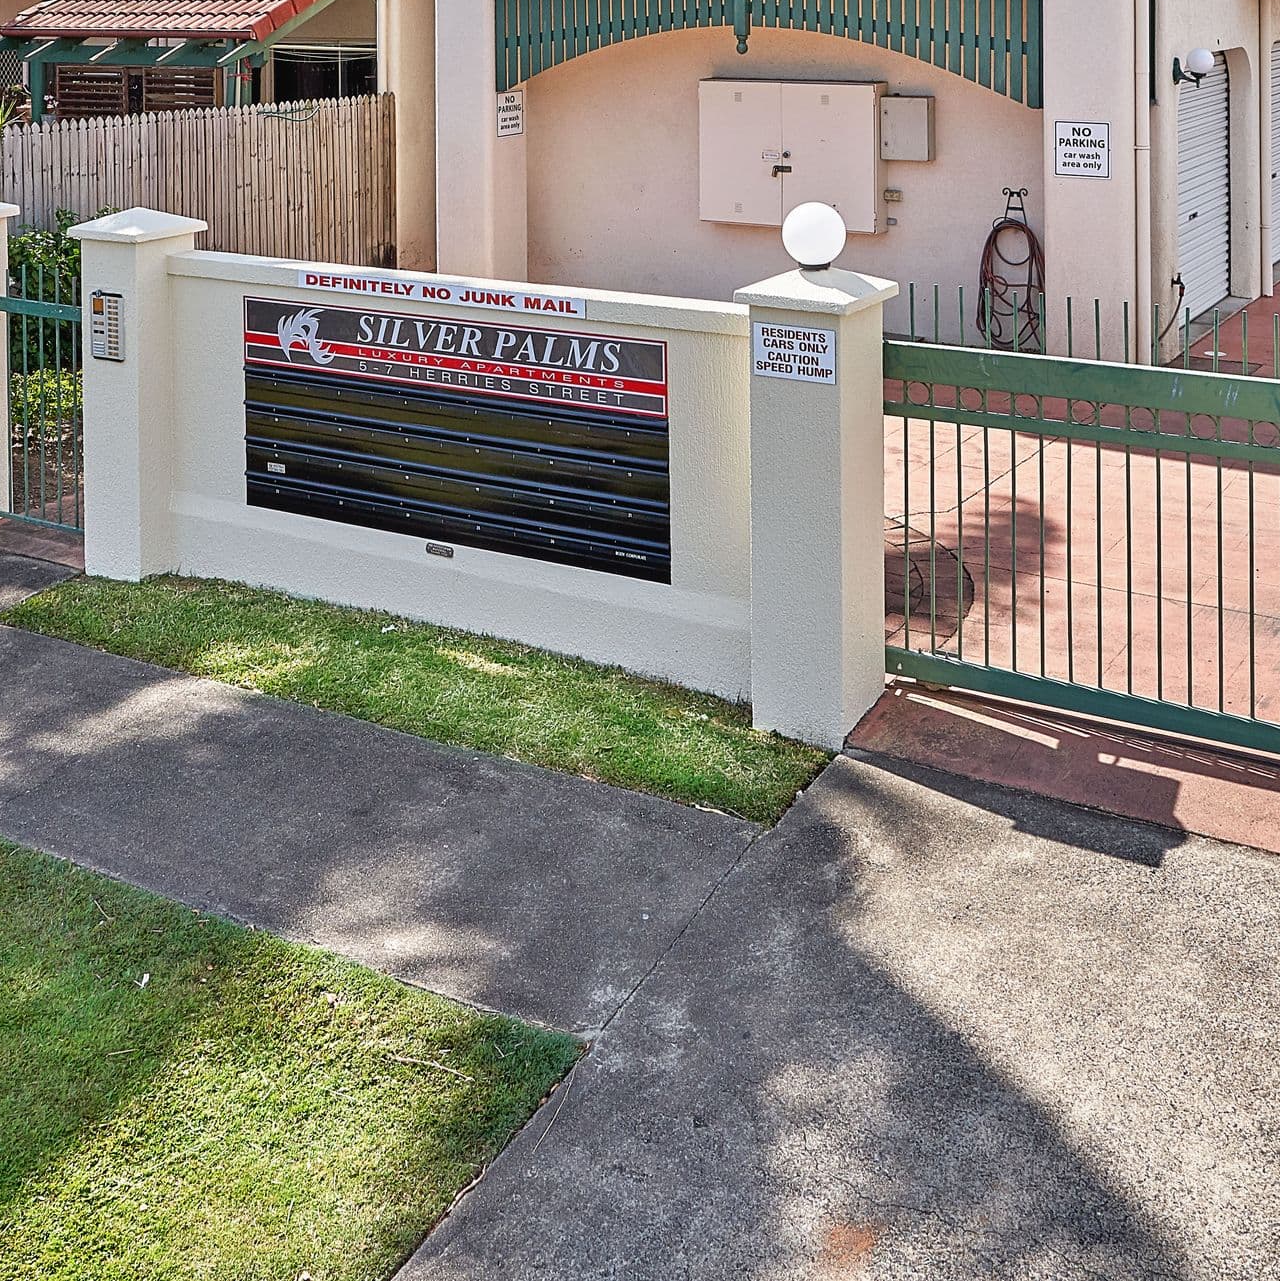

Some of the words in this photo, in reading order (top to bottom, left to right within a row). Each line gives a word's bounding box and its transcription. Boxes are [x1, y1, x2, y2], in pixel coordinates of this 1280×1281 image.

[504, 95, 516, 104] NO
[498, 104, 522, 113] PARKING
[1071, 127, 1092, 137] NO
[1058, 137, 1105, 149] PARKING
[1078, 151, 1101, 160] wash
[1082, 161, 1102, 171] only
[305, 274, 415, 296] DEFINITELY
[422, 286, 451, 300] NO
[459, 290, 516, 308] JUNK
[523, 297, 578, 314] MAIL
[761, 327, 826, 343] RESIDENTS
[356, 315, 482, 356] SILVER
[491, 330, 622, 373] PALMS
[763, 338, 795, 350] CARS
[798, 342, 829, 354] ONLY
[767, 351, 819, 366] CAUTION
[358, 349, 445, 365] LUXURY
[460, 361, 625, 389] APARTMENTS
[756, 360, 793, 374] SPEED
[797, 365, 833, 379] HUMP
[358, 361, 393, 375] 5-7
[409, 367, 511, 391] HERRIES
[528, 383, 625, 405] STREET
